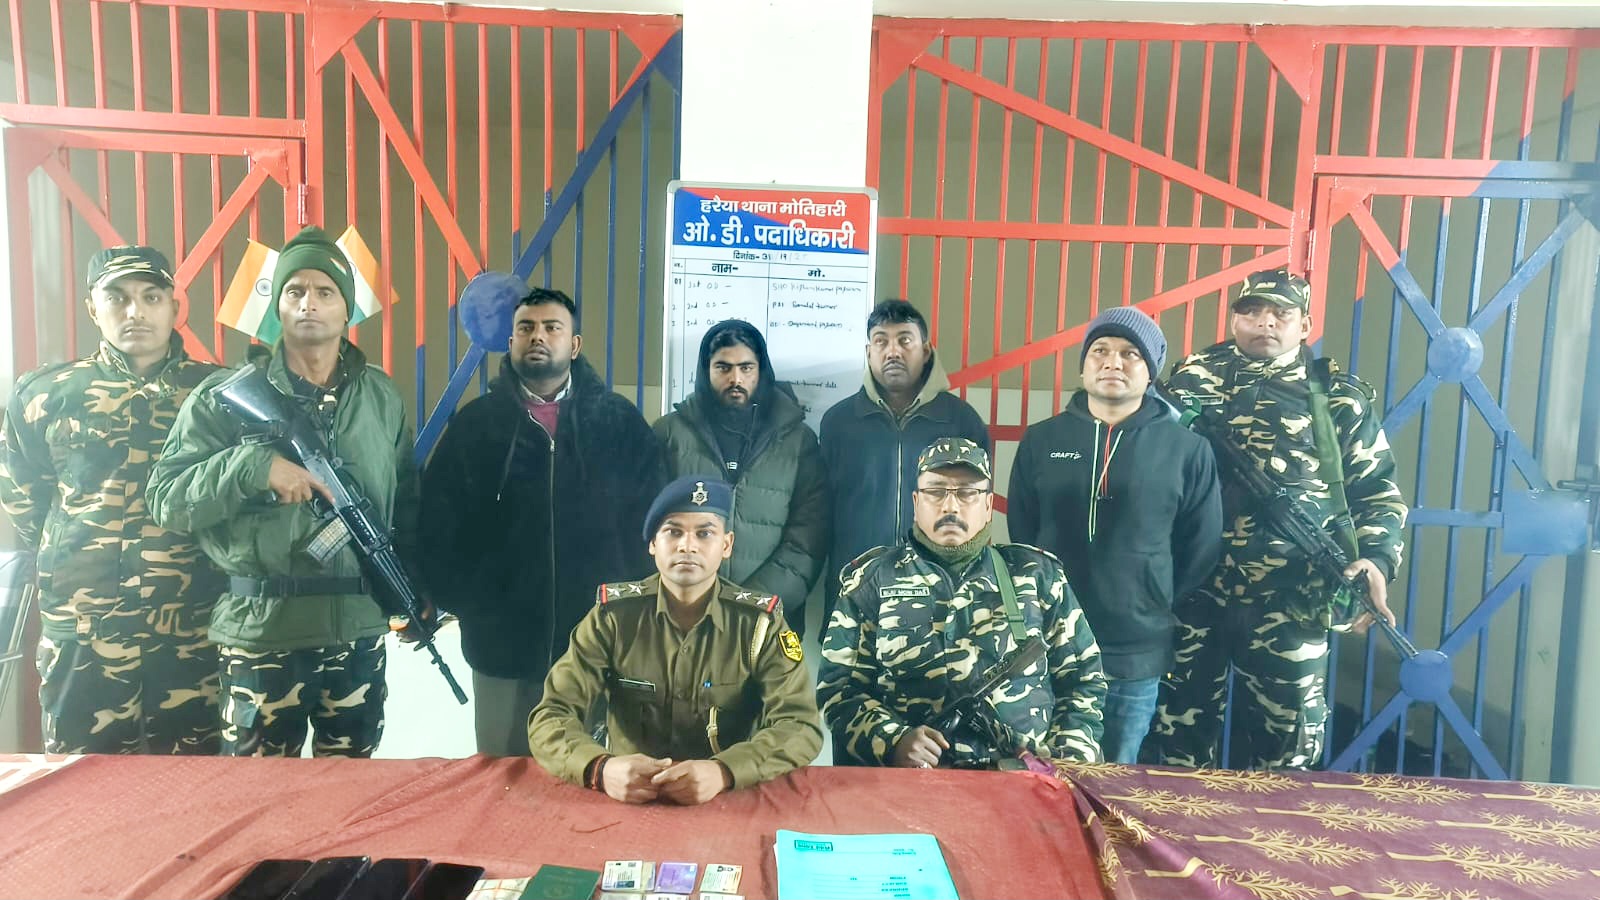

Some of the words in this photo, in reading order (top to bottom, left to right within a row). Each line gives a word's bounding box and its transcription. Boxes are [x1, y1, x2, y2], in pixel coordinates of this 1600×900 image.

[700, 195, 739, 213] हरैया
[741, 199, 777, 215] थाना
[779, 197, 847, 217] मोतिहारी
[683, 216, 717, 242] ओ.
[721, 215, 750, 245] डी.
[754, 219, 856, 250] पदाधिकारी
